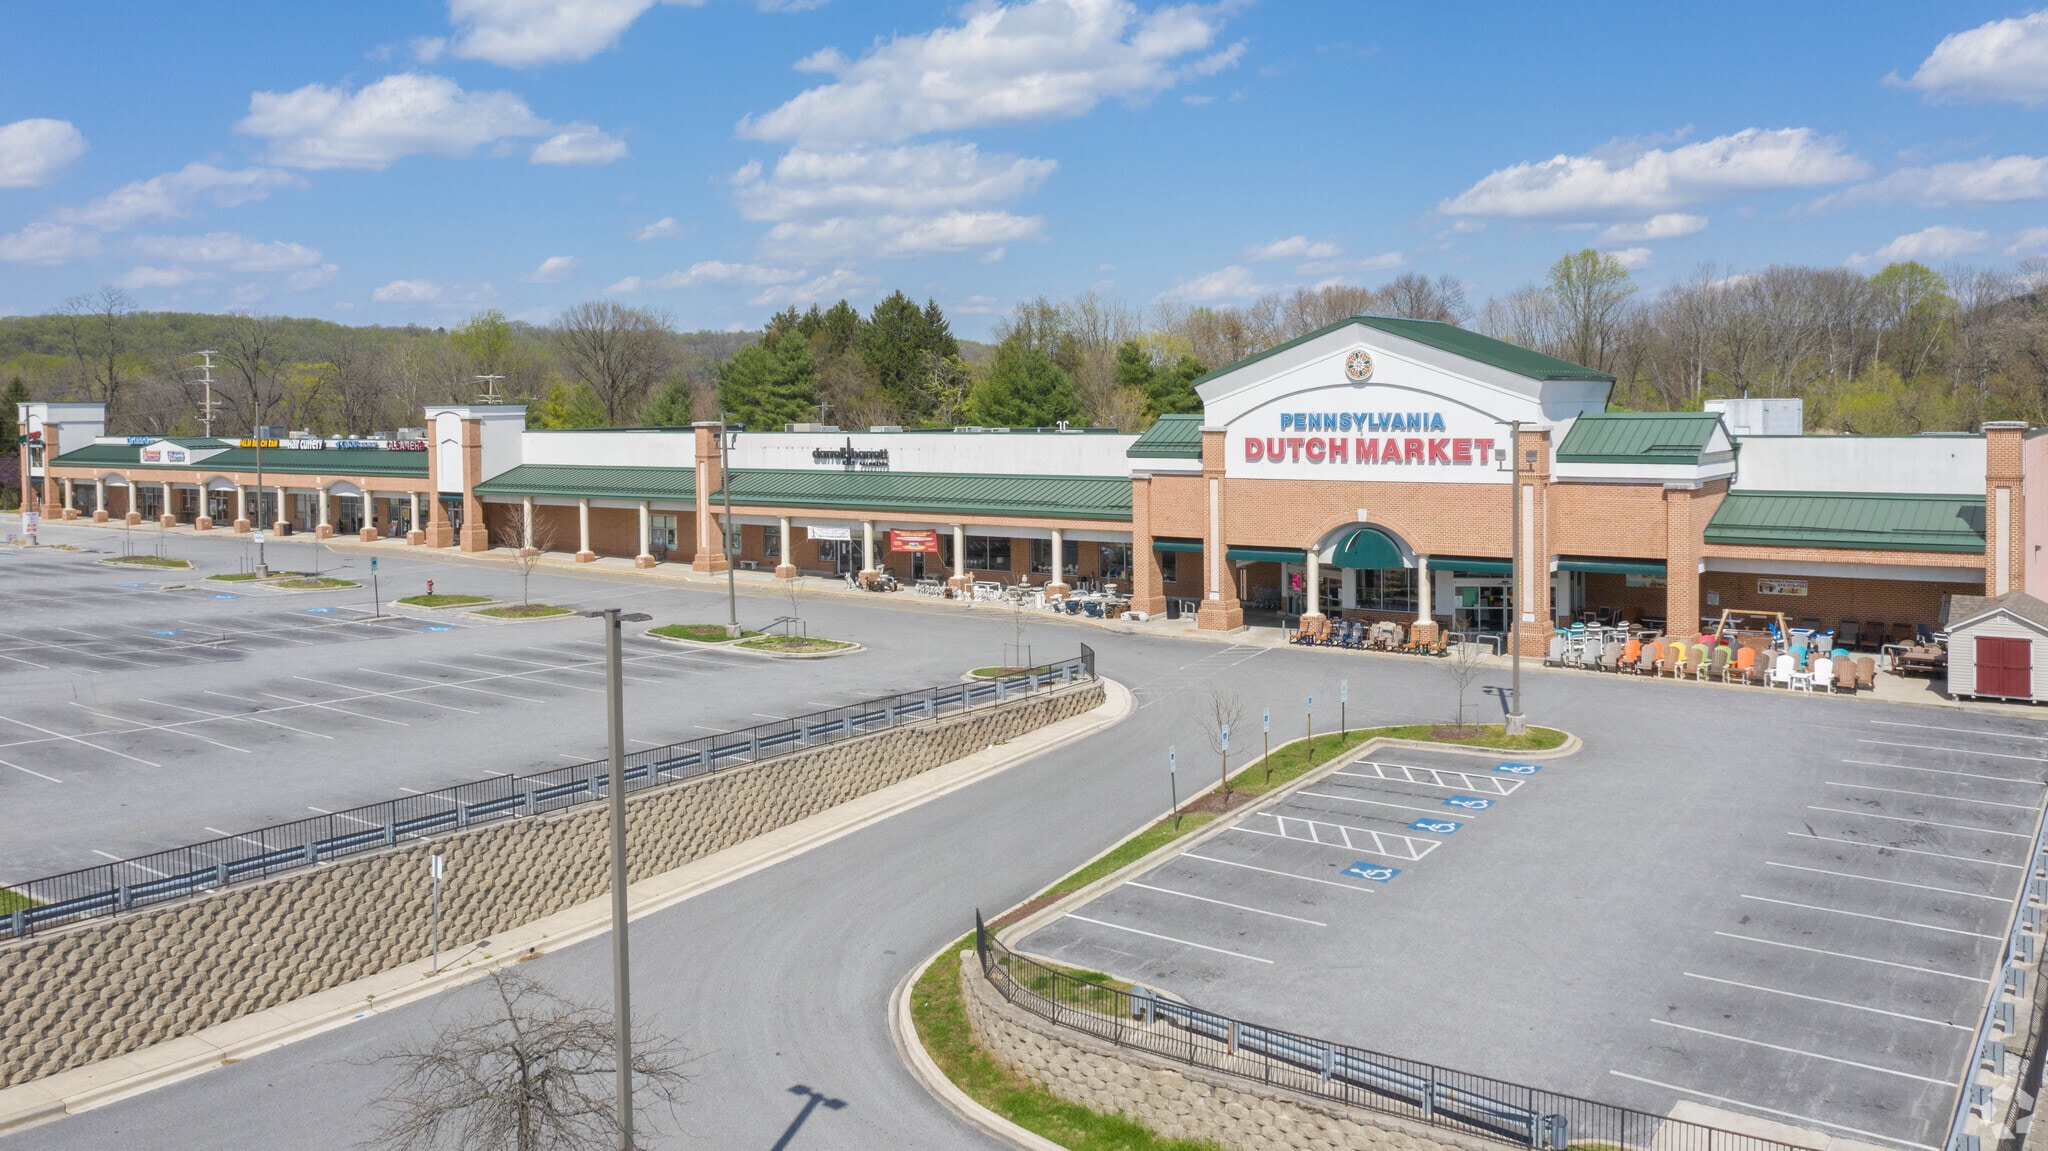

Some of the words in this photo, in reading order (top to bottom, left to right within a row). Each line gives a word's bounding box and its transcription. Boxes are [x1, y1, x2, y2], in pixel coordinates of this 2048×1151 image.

[1280, 412, 1445, 430] PENNSYLVANIA
[239, 438, 252, 448] PALM
[1245, 437, 1348, 462] DUTCH
[1355, 438, 1495, 463] MARKET
